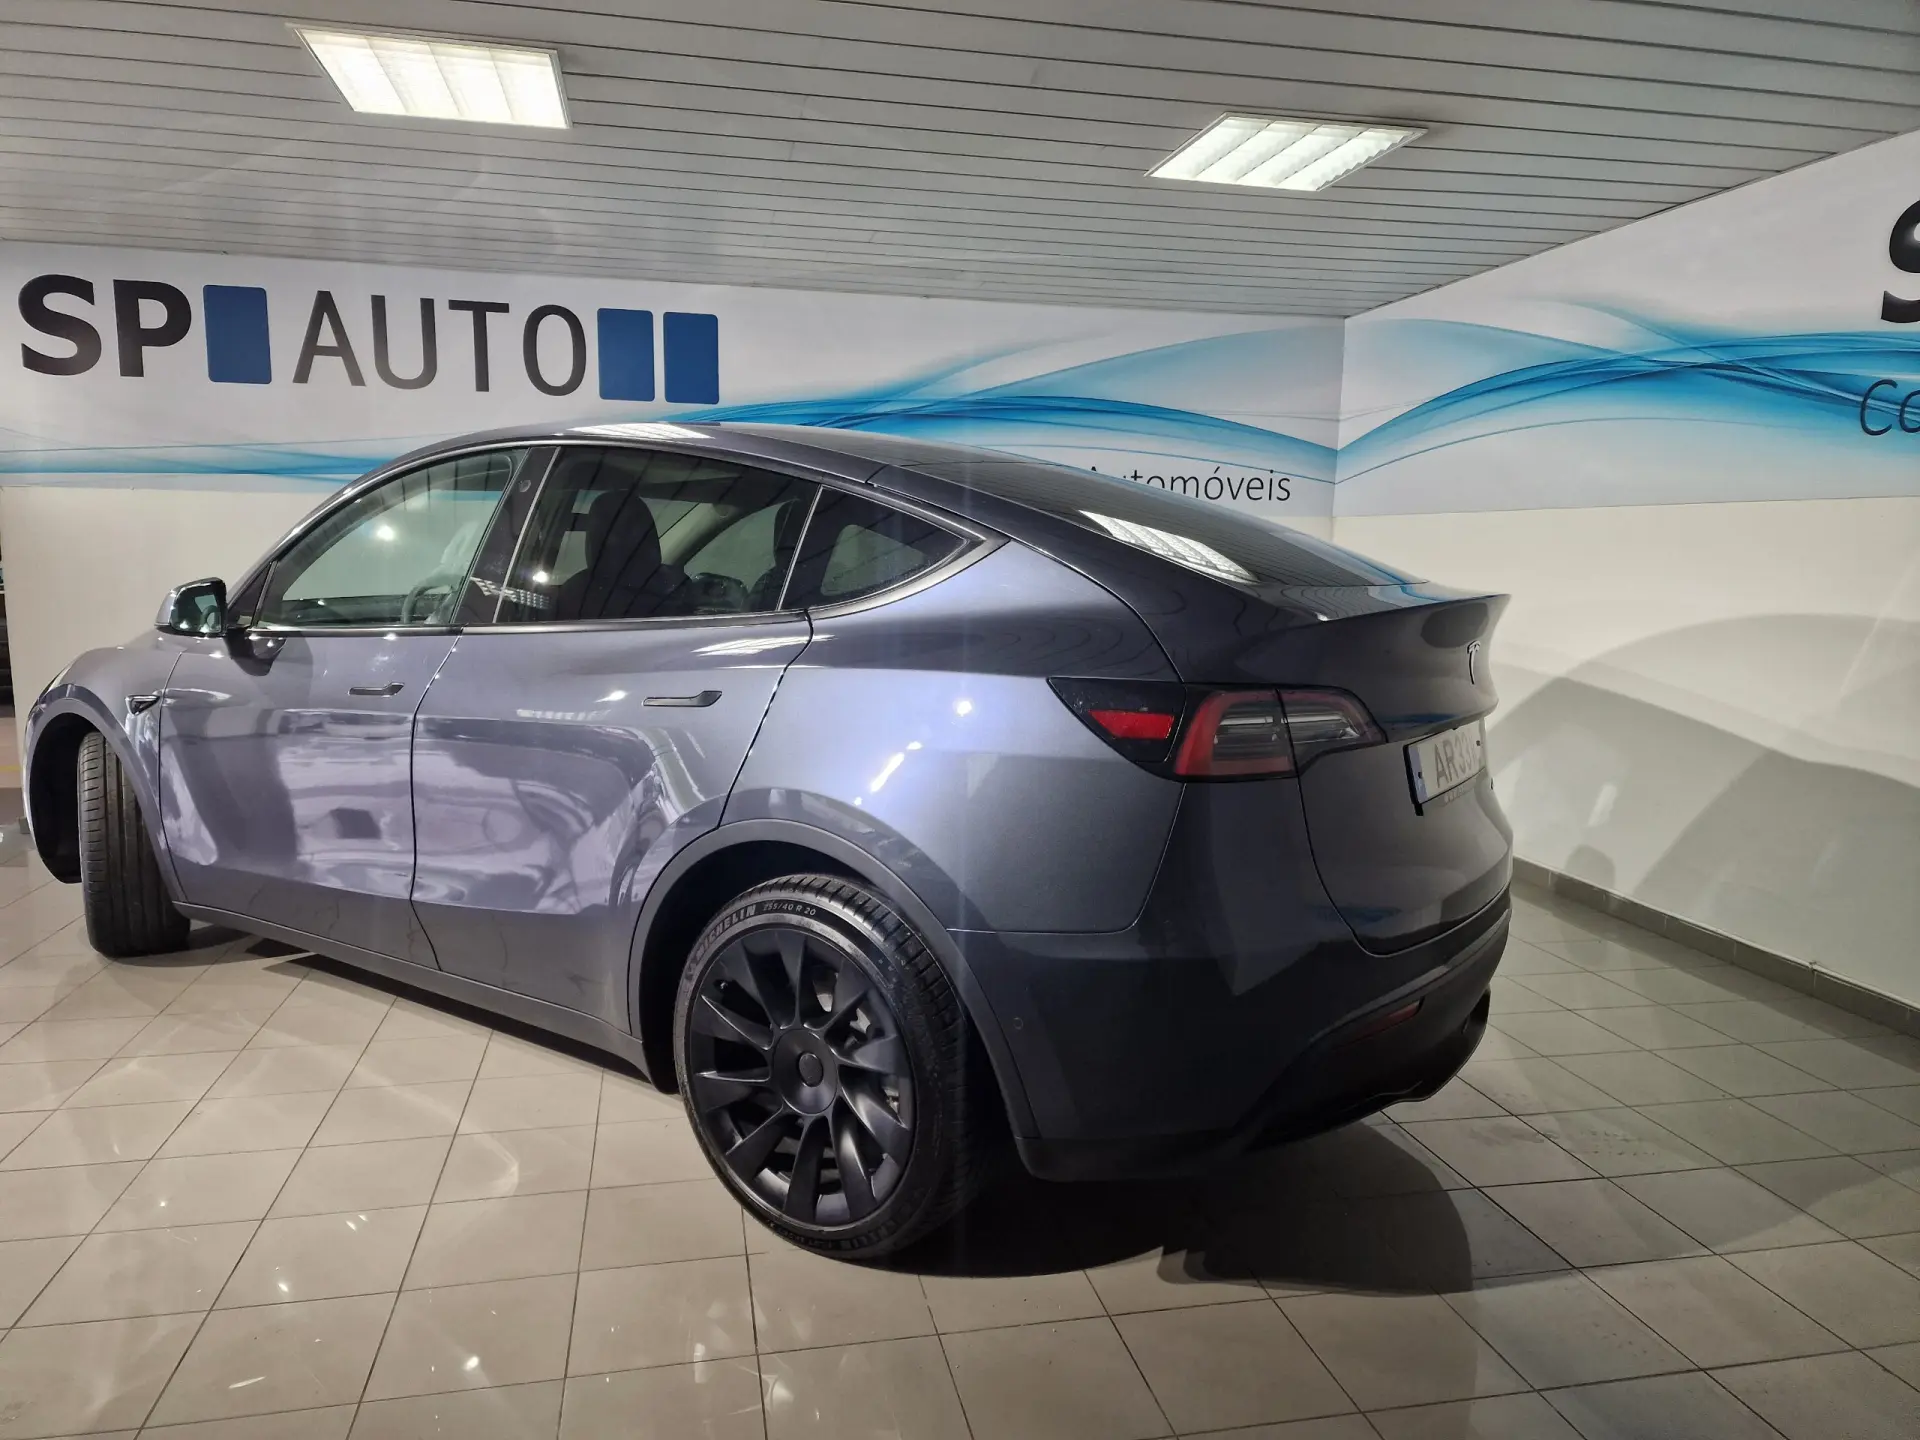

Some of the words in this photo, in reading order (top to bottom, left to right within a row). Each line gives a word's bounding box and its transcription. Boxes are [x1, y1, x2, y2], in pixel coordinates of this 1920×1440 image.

[18, 273, 192, 378] SP
[292, 289, 587, 397] AUTO
[1091, 465, 1291, 501] móveis
[804, 906, 816, 916] 20
